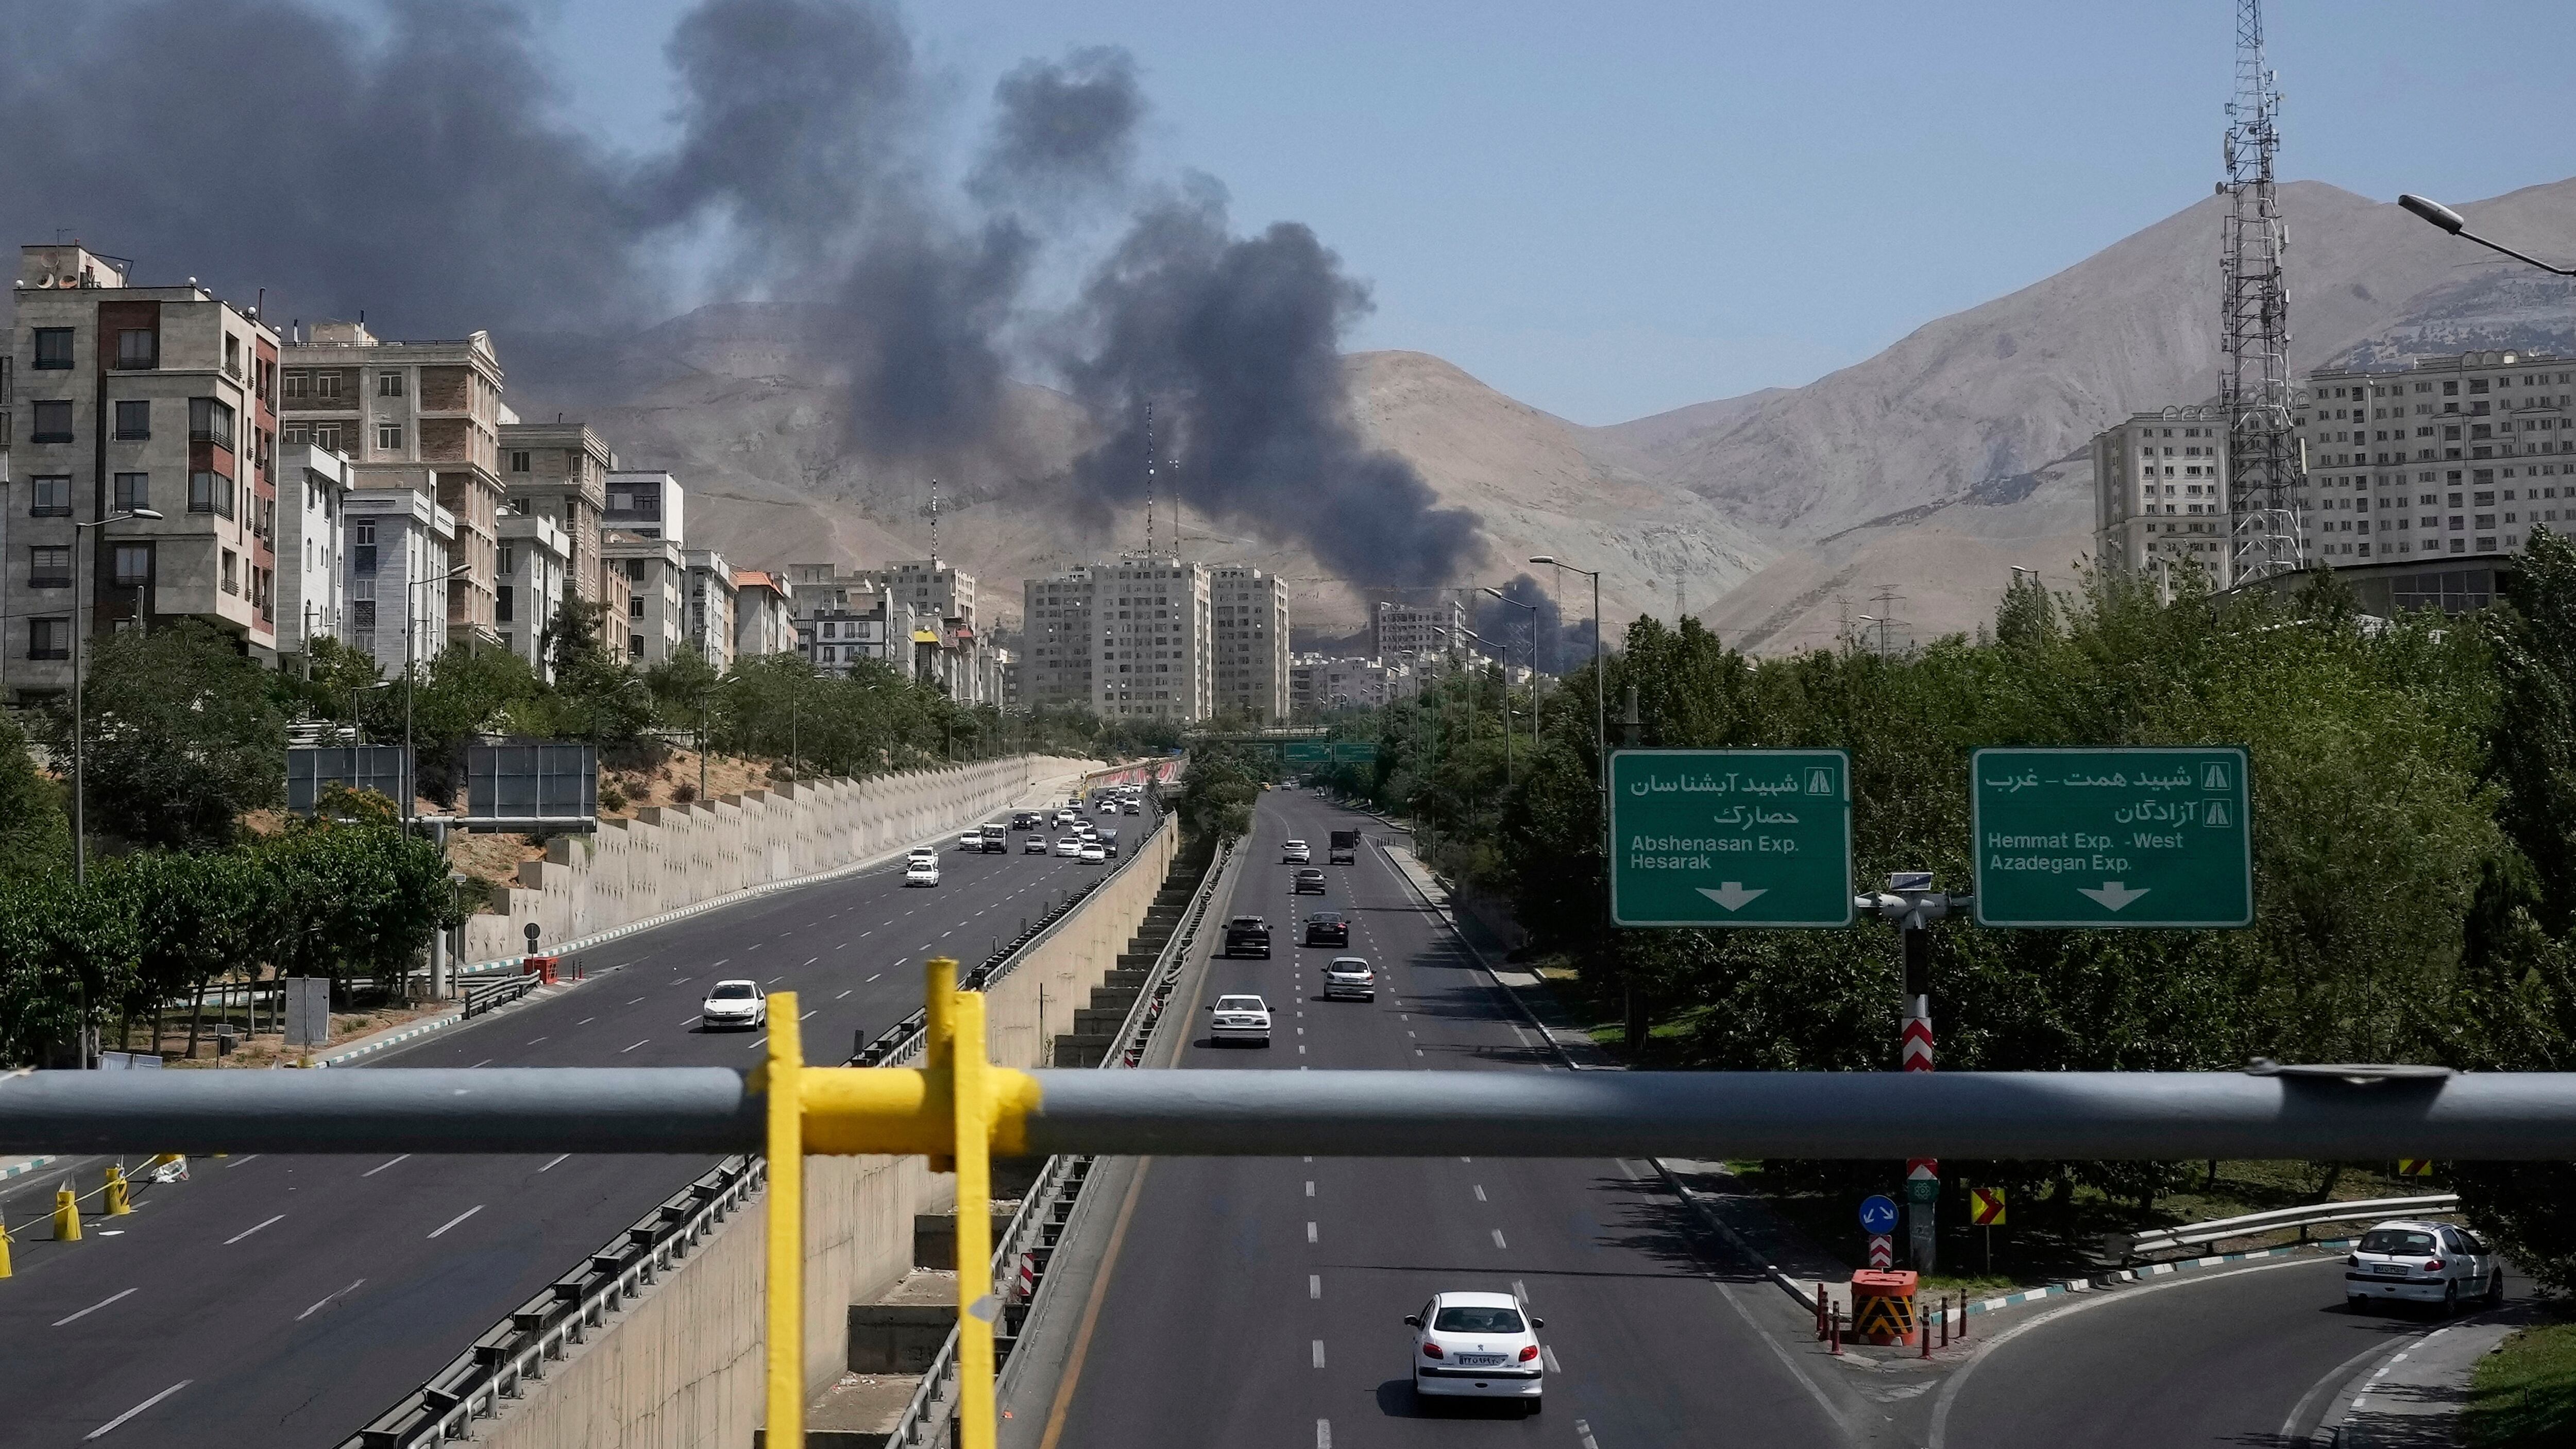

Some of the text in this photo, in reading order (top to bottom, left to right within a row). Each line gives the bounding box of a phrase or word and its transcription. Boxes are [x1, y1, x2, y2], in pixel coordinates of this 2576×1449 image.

[1631, 773, 1798, 796] شهید آبشناسان
[1985, 768, 2038, 793] غرب
[2063, 772, 2127, 787] همت
[2133, 765, 2192, 791] شهید
[1714, 806, 1799, 831] حصارک
[2115, 800, 2198, 828] آزادگان
[1632, 835, 1799, 855] Abshenasan Exp.
[1988, 832, 2069, 848] Hemmat
[2075, 832, 2114, 851] Exp.
[1631, 854, 1711, 870] Hesarak
[1990, 855, 2132, 874] Azadegan Exp.
